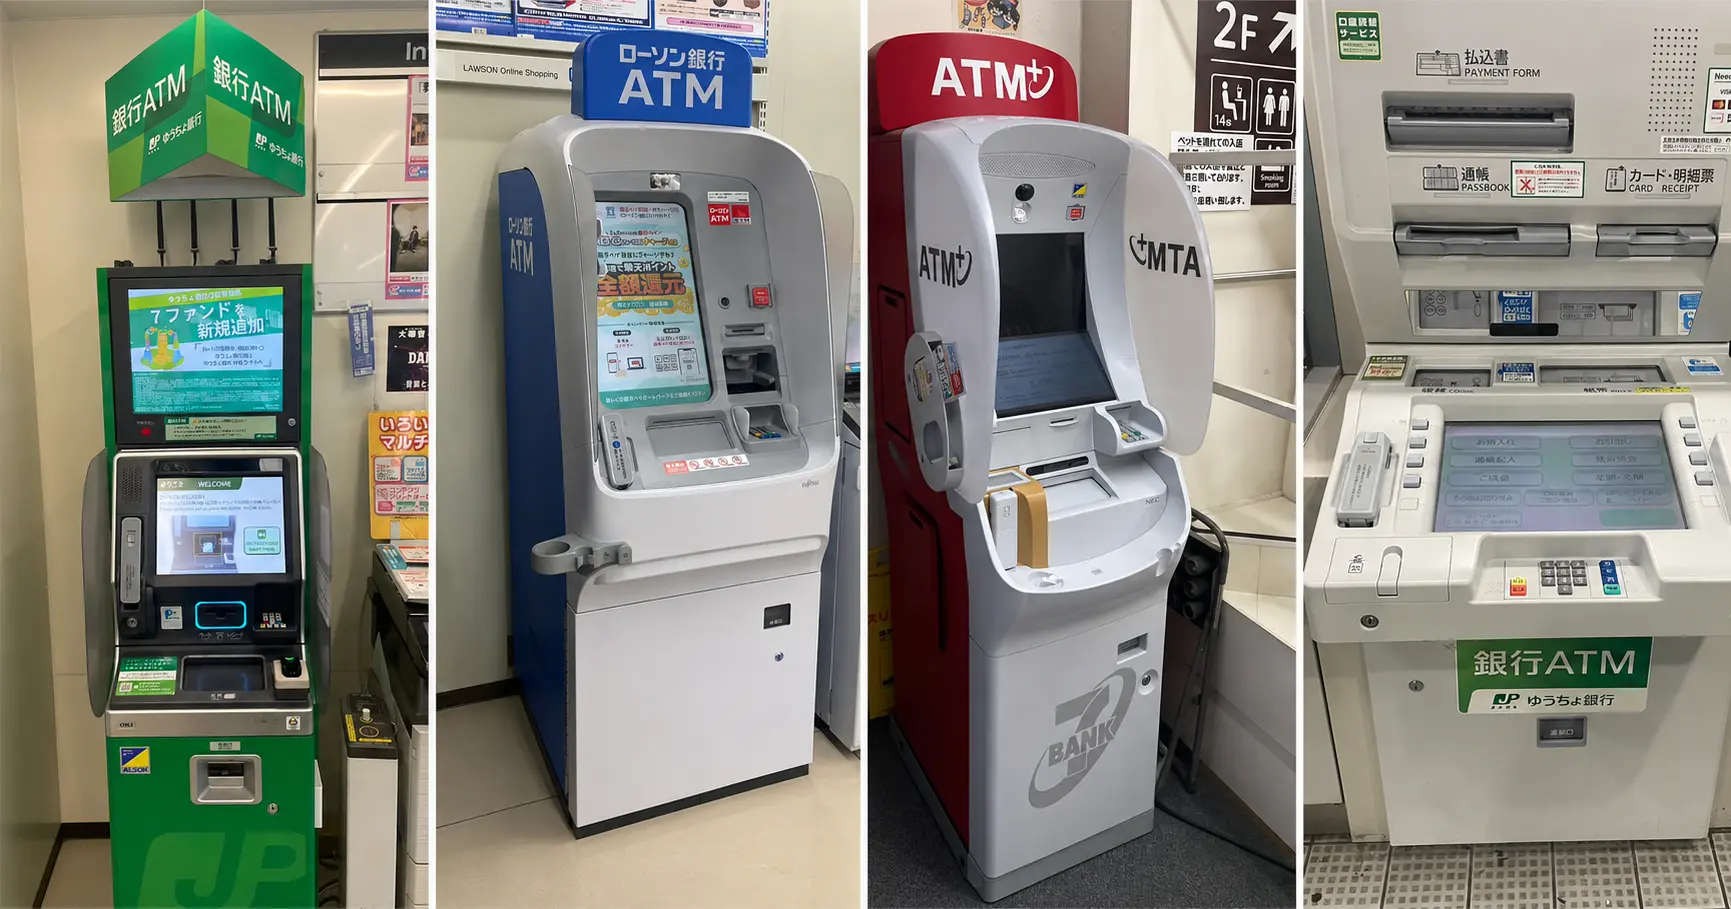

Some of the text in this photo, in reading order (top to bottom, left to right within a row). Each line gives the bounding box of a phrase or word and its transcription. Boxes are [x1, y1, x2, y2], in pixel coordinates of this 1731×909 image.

[1214, 1, 1258, 51] 2F
[1340, 29, 1378, 38] サービス
[619, 44, 725, 71] ローソン銀行
[1465, 49, 1508, 65] 払込書
[463, 65, 559, 79] LAWSON Online Shopping
[1465, 69, 1541, 77] PAYMENT FORM
[213, 55, 291, 125] 銀行ATM
[618, 69, 723, 109] ATM
[112, 64, 186, 136] 銀行ATM
[1261, 173, 1284, 182] Smoking
[1461, 166, 1489, 181] 通帳
[1629, 169, 1714, 183] カード・明細票
[1461, 183, 1510, 191] PASSBOOK
[1629, 184, 1699, 192] CARD RECEIPT
[511, 238, 534, 276] ATM
[197, 318, 264, 340] 新規追加
[1473, 650, 1636, 676] 銀行ATM
[1527, 694, 1615, 707] ゆうちょ銀行
[1048, 717, 1116, 767] BANK
